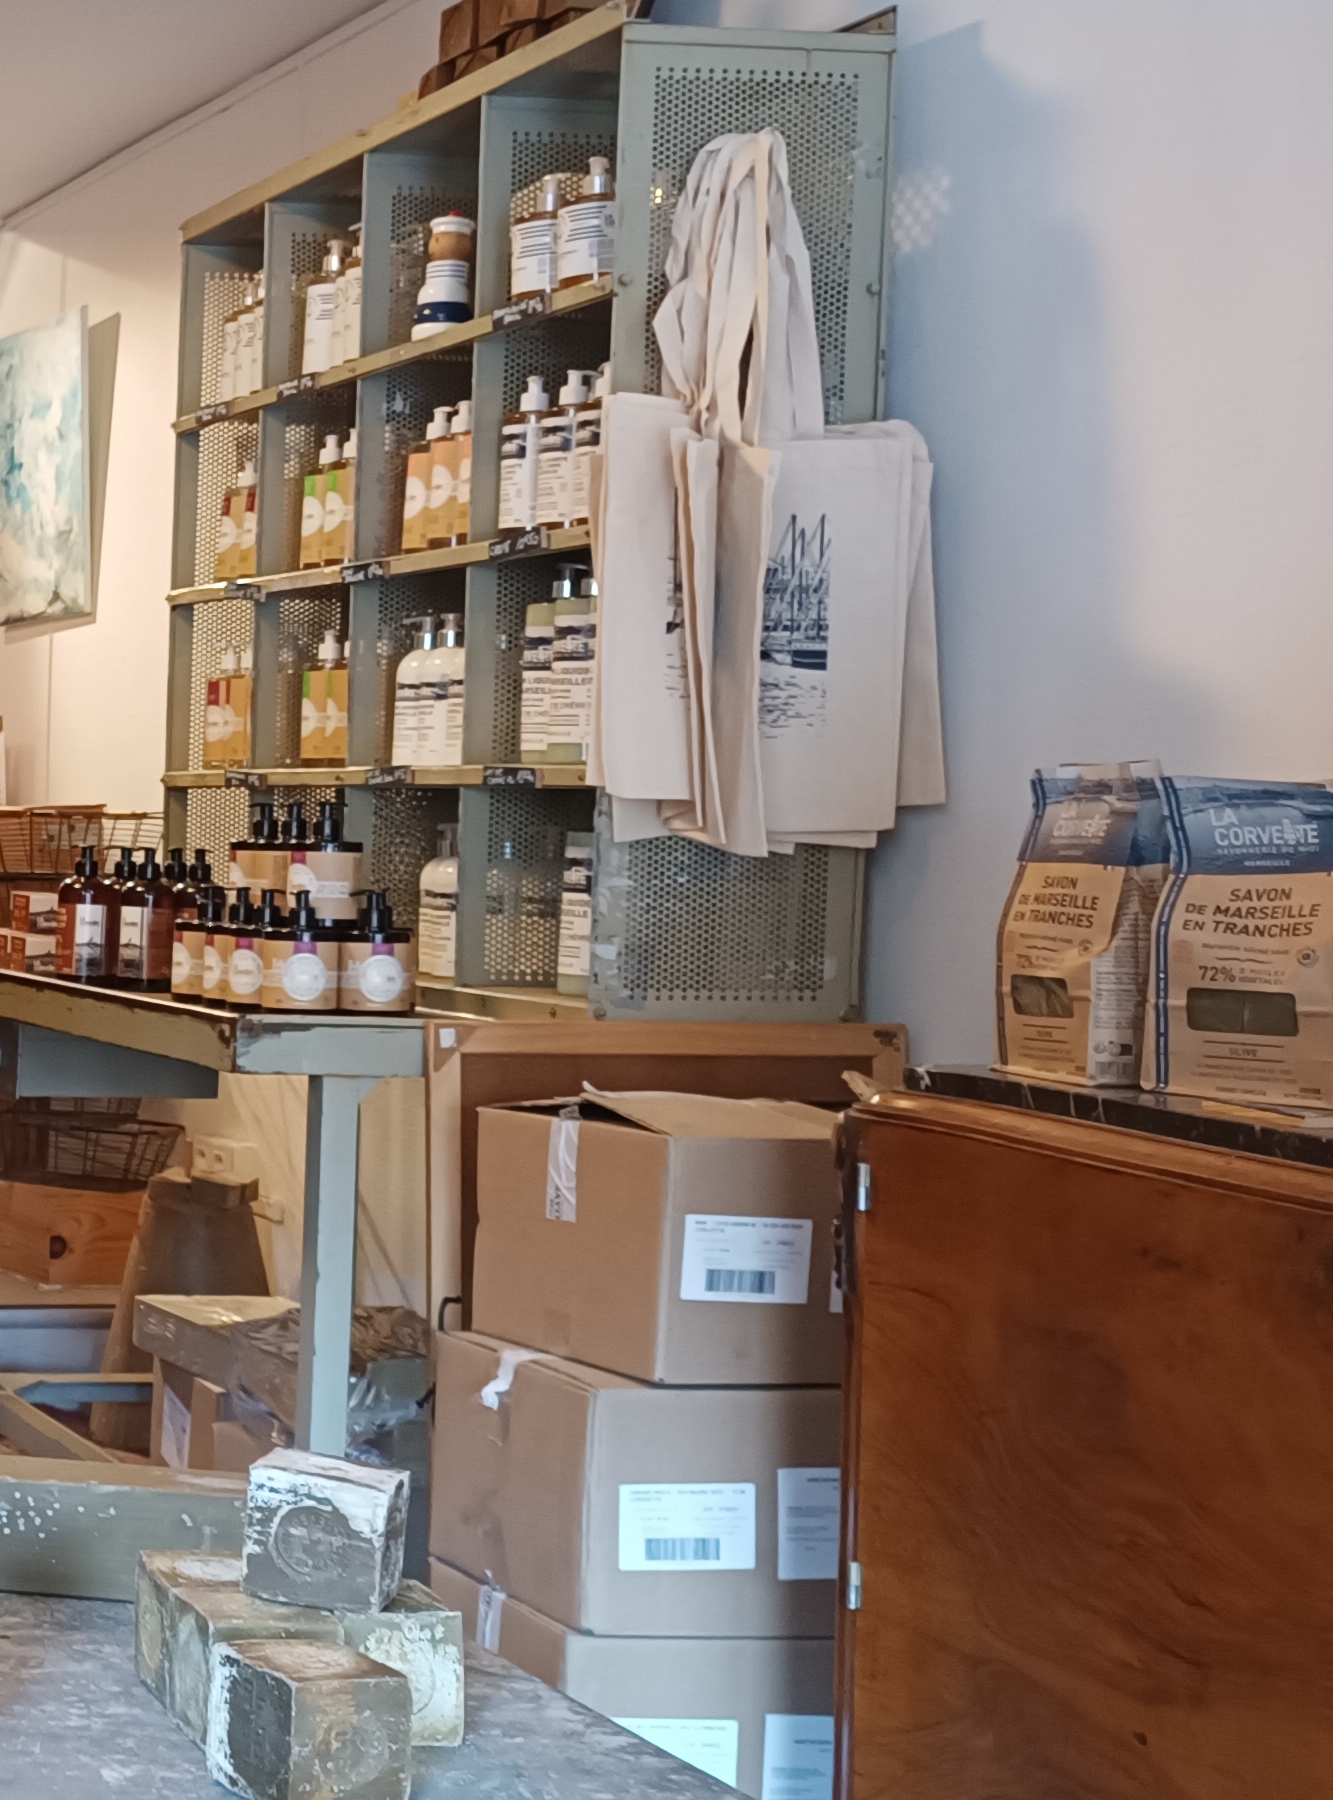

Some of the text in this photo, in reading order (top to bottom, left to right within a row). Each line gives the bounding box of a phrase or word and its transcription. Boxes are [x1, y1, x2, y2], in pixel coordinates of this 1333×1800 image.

[1209, 807, 1239, 826] LA
[1041, 875, 1079, 890] SAVON
[1018, 893, 1100, 911] DE MARSEILLE
[1228, 887, 1293, 902] SAVON
[1013, 909, 1094, 928] EN TRANCHES
[1185, 903, 1322, 920] DE MARSEILLE
[1182, 919, 1314, 938] EN TRANCHES
[1198, 965, 1237, 982] 72%
